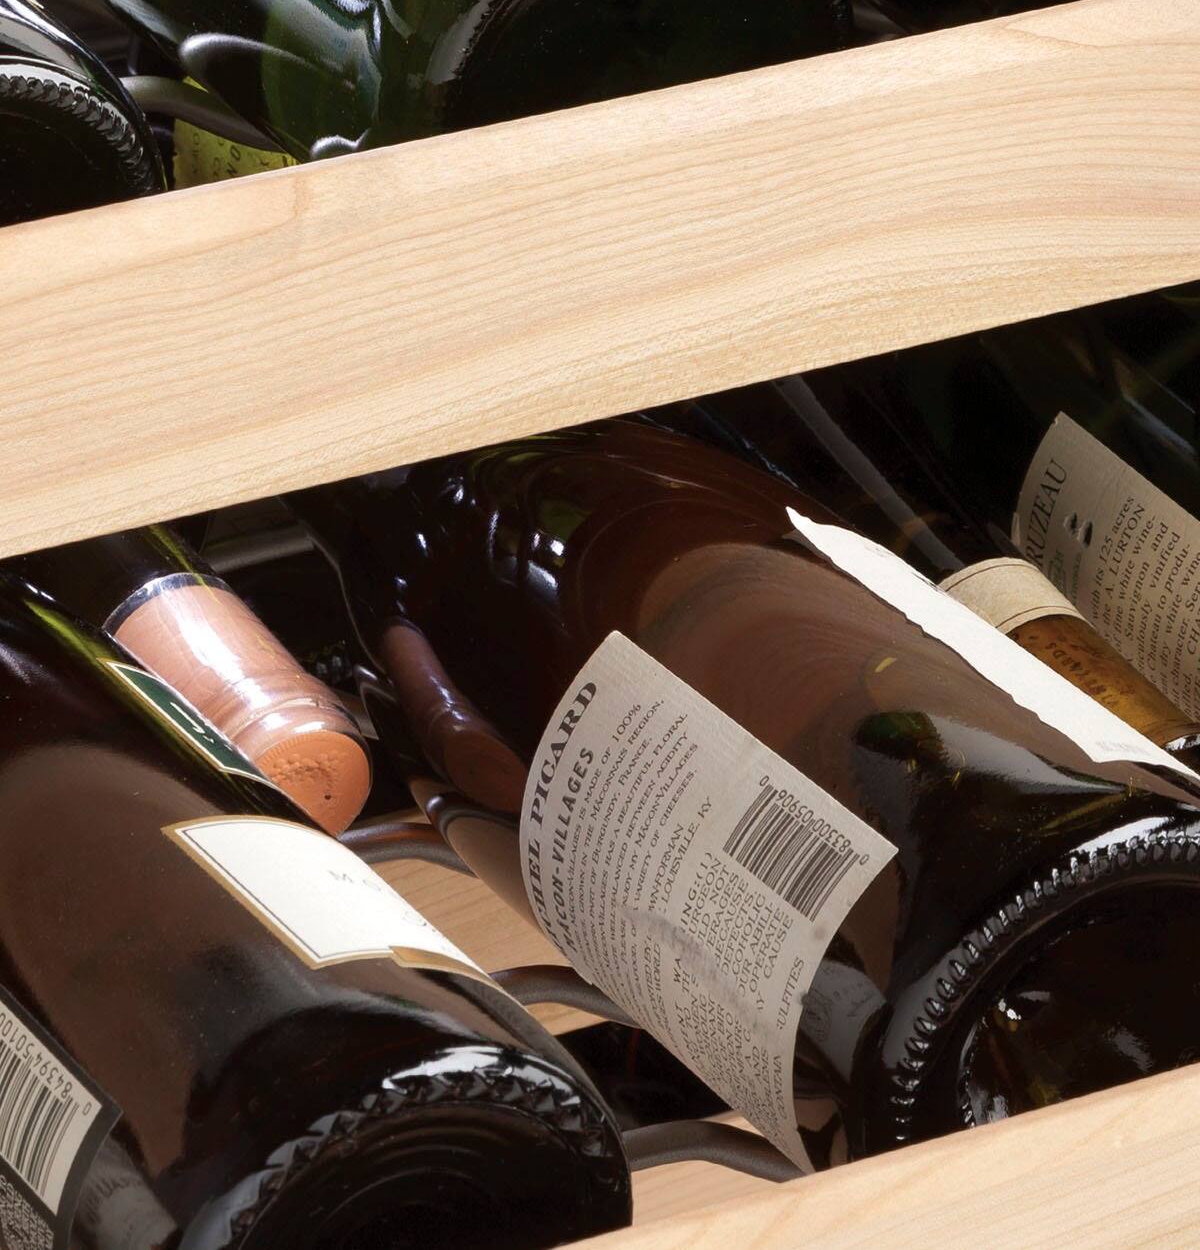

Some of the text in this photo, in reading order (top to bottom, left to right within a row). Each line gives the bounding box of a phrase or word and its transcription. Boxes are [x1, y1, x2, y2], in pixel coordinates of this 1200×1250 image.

[1026, 458, 1067, 568] RUZEAU
[1099, 535, 1114, 564] 125
[1111, 497, 1135, 535] acres
[1109, 503, 1146, 577] LURTON
[1118, 559, 1136, 600] white
[1132, 515, 1156, 555] wine-
[1125, 522, 1169, 642] Sauvignon and
[1150, 531, 1181, 588] vinified
[1146, 543, 1191, 671] Chateau to produ-
[1165, 593, 1183, 634] white
[530, 681, 597, 831] PICARD
[584, 768, 602, 803] MADE
[601, 746, 612, 765] OF
[611, 703, 642, 743] 100%
[625, 779, 657, 839] BETWEEN
[656, 730, 689, 779] ACIDITY
[604, 838, 615, 867] HAS
[617, 758, 654, 825] BEAUTIFUL
[652, 713, 689, 757] FLORAL
[696, 794, 713, 819] KY
[776, 789, 815, 824] 05906
[584, 824, 596, 848] THE
[648, 823, 684, 911] WN-FORMAN
[650, 830, 661, 849] OF
[812, 817, 852, 853] 83300
[622, 871, 632, 908] NJOY
[690, 857, 722, 935] URGEON
[709, 863, 731, 904] NOT
[731, 892, 766, 977] COHOLIC
[749, 907, 785, 994] OPERATE
[763, 914, 794, 980] CAUSE
[32, 1051, 73, 1100] 84394
[773, 1054, 787, 1120] CONTAIN
